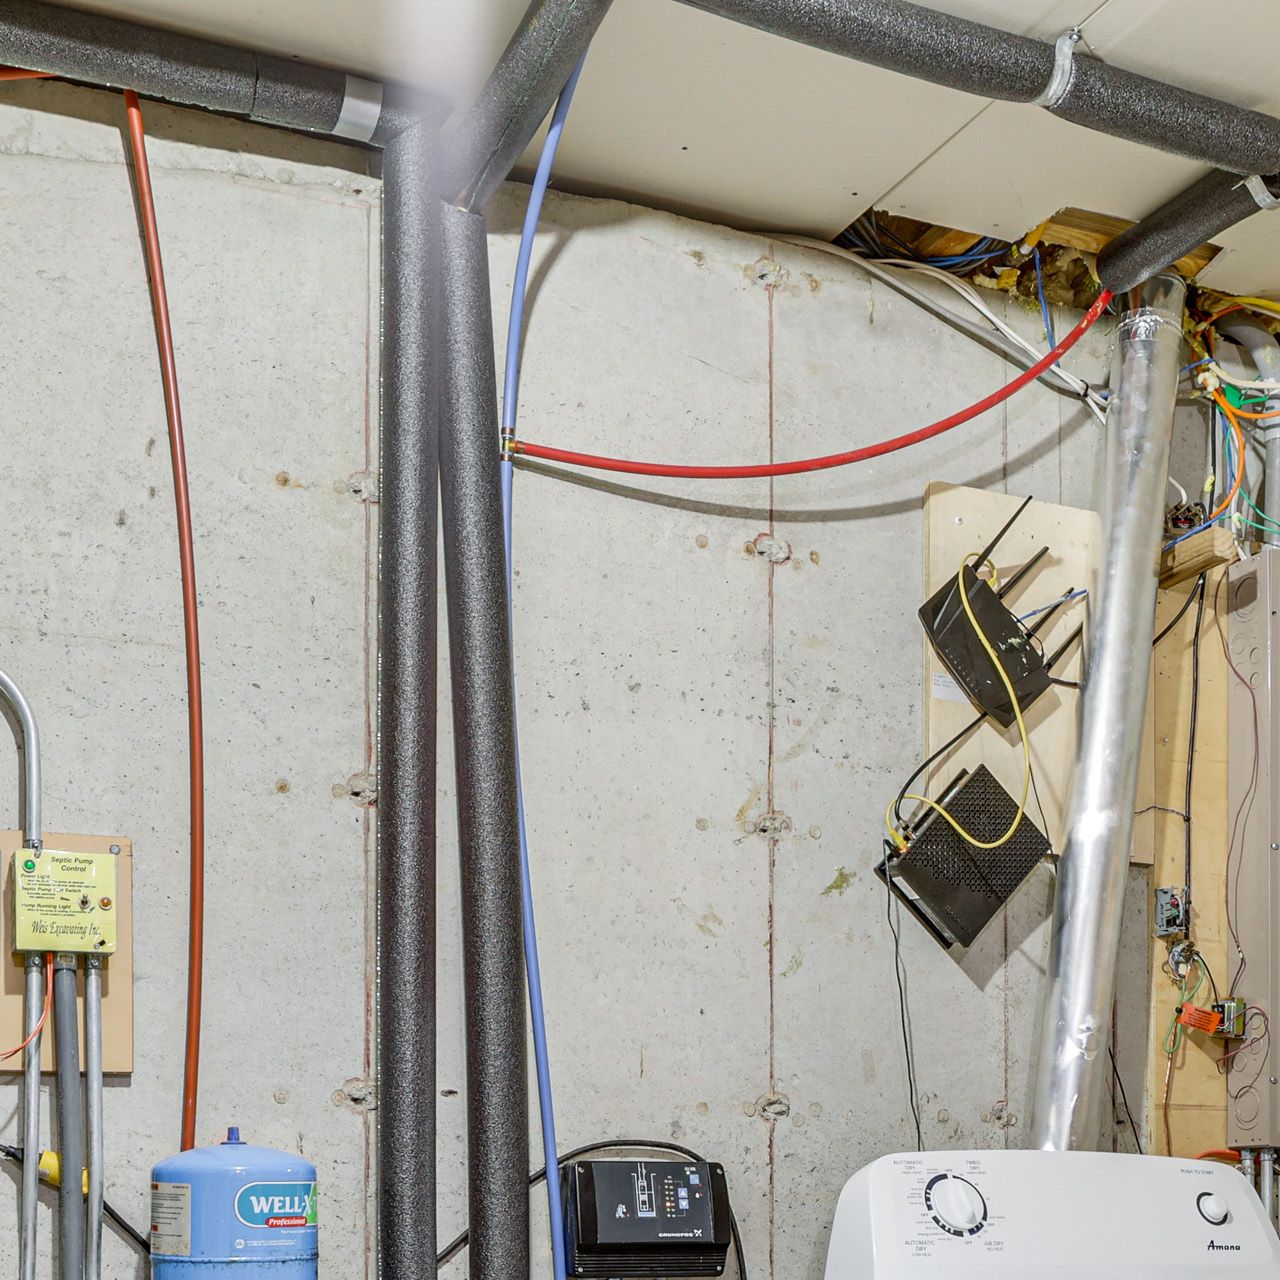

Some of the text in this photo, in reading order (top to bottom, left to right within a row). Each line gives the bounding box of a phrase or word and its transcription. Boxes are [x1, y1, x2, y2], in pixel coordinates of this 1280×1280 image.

[51, 856, 94, 865] Septic Pump
[1207, 1239, 1241, 1251] Amana
